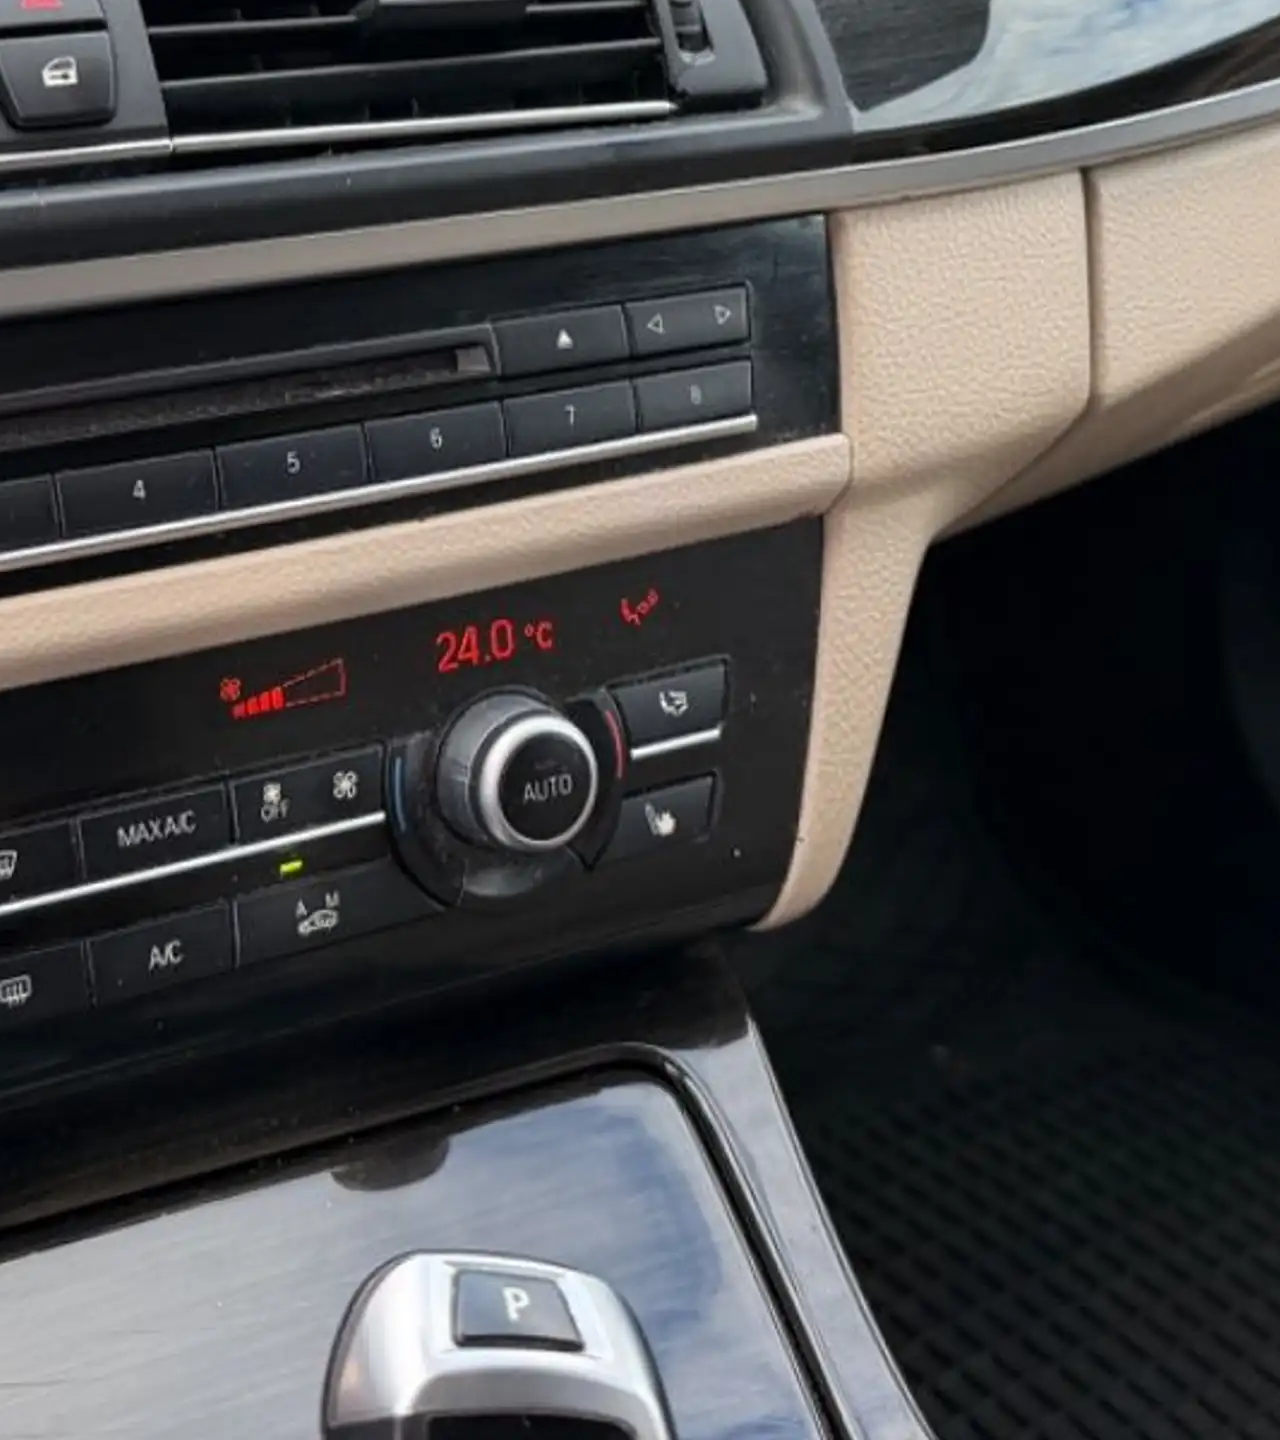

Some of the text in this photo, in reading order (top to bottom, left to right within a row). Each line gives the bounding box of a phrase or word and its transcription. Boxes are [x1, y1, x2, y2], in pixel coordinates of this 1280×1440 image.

[563, 403, 576, 426] 7
[428, 427, 444, 449] 6
[286, 450, 301, 474] 5
[131, 479, 147, 500] 4
[436, 618, 516, 673] 24.0
[523, 773, 573, 803] AUTO
[116, 817, 164, 849] MAX
[149, 939, 183, 971] A/C
[501, 1286, 532, 1322] P
